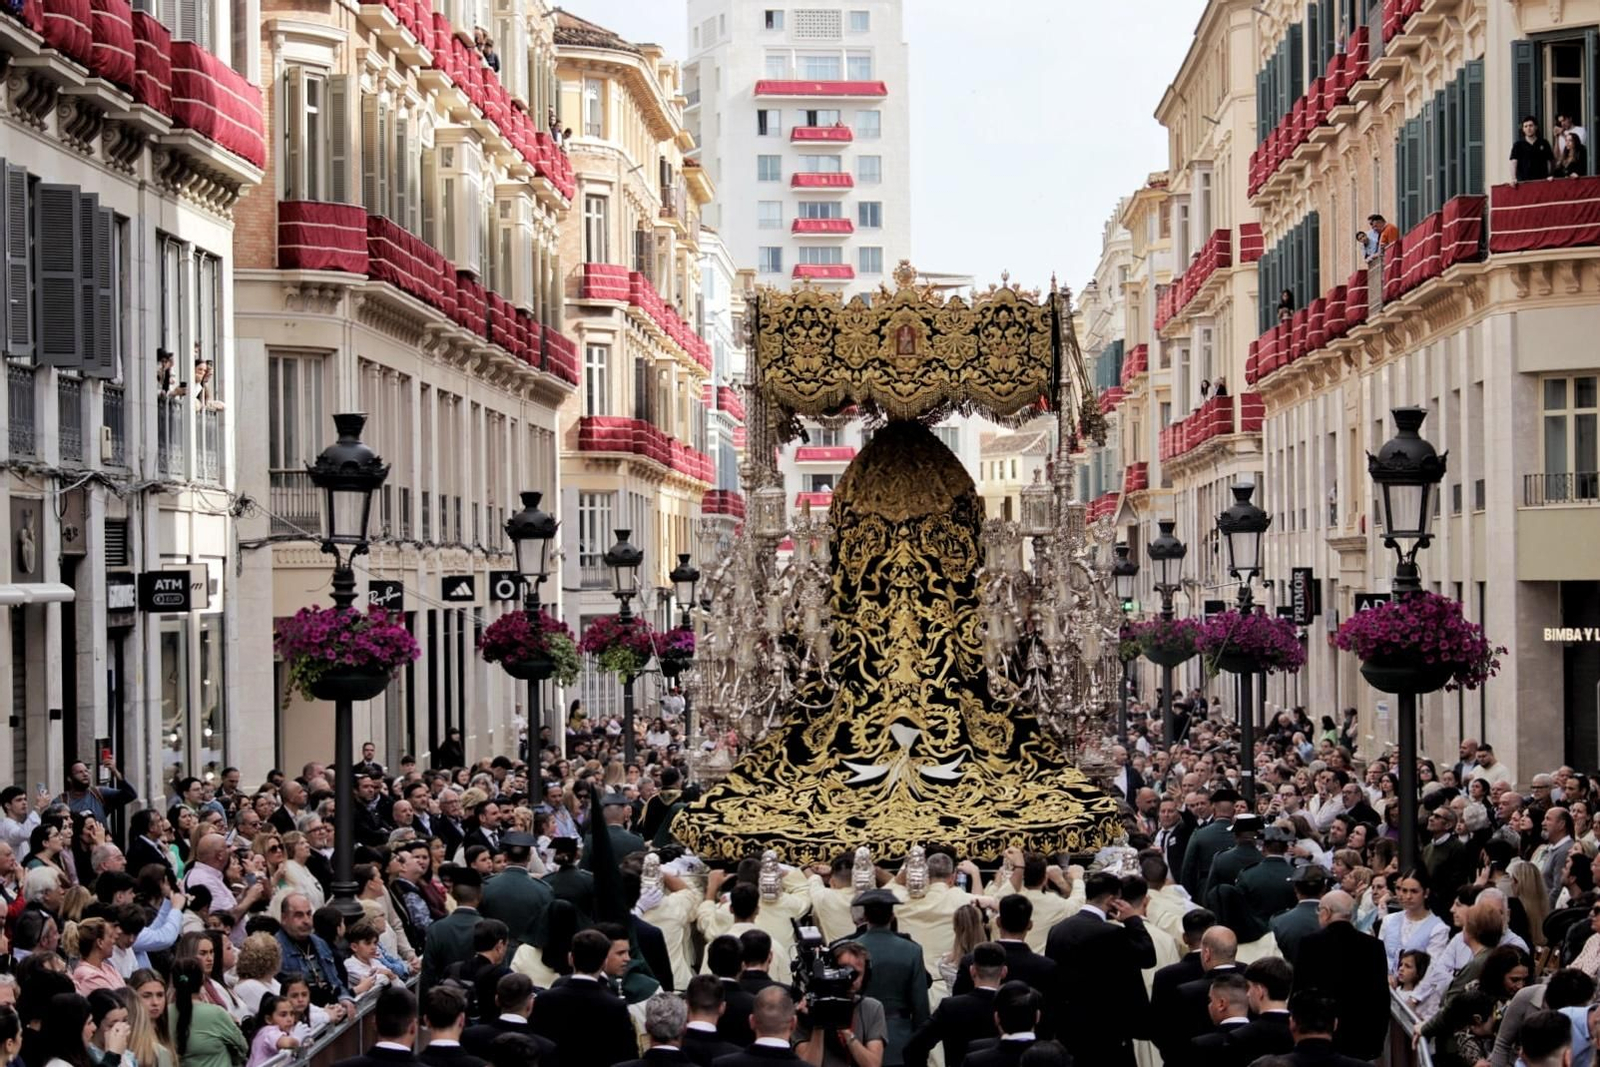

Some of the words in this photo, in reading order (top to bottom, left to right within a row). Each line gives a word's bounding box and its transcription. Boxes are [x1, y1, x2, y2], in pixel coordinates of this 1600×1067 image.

[154, 579, 182, 590] ATM
[1294, 571, 1305, 622] PRIMOR
[1544, 627, 1583, 641] BIMBA
[1583, 627, 1593, 641] Y
